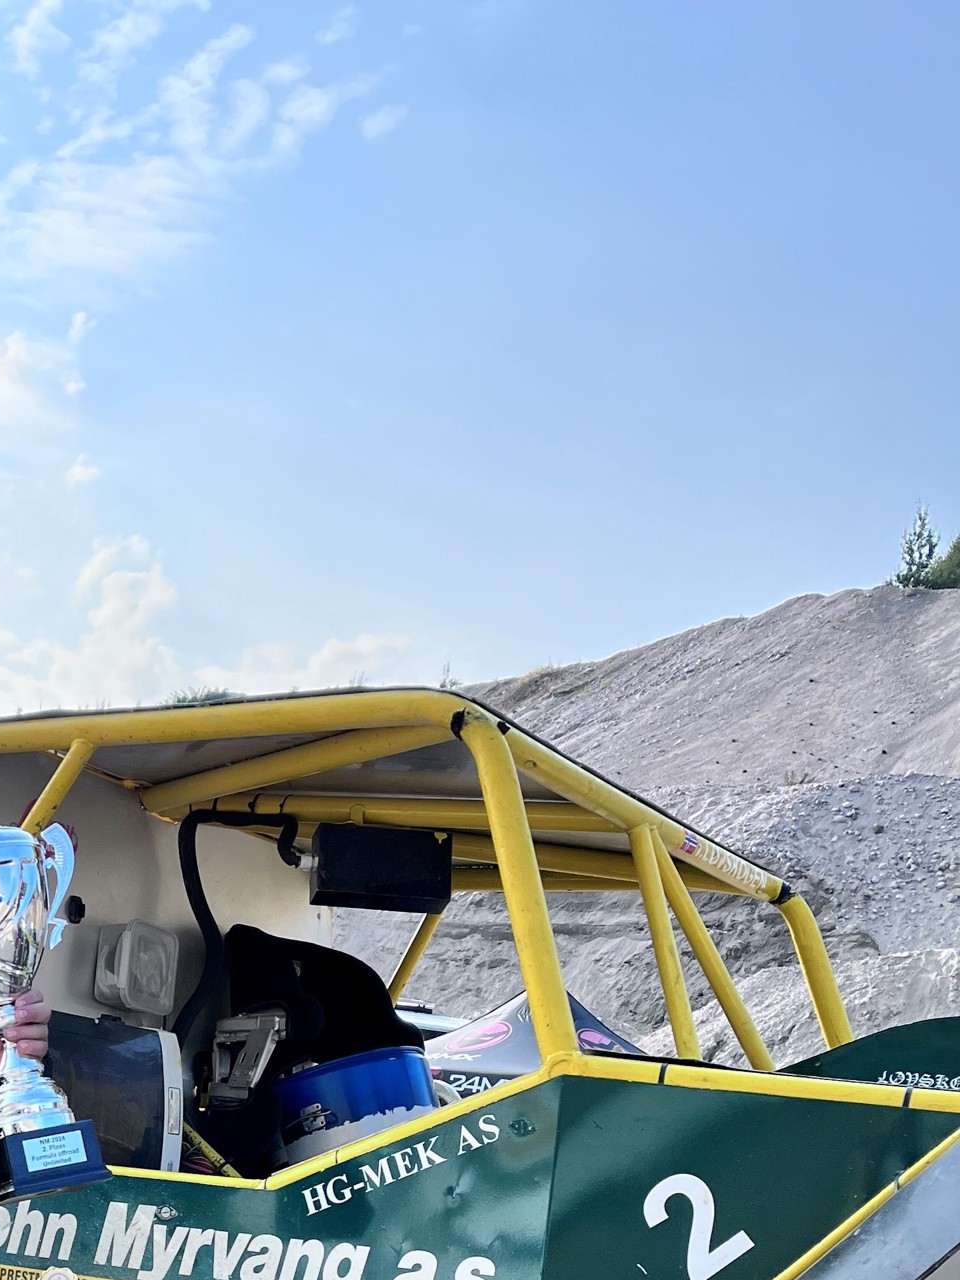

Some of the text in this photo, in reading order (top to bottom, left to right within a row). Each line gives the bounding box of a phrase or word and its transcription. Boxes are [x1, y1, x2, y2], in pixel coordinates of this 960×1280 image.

[31, 1148, 80, 1162] Formula offroad
[42, 1157, 72, 1167] Unlimited
[301, 1114, 500, 1217] HG-MEK AS
